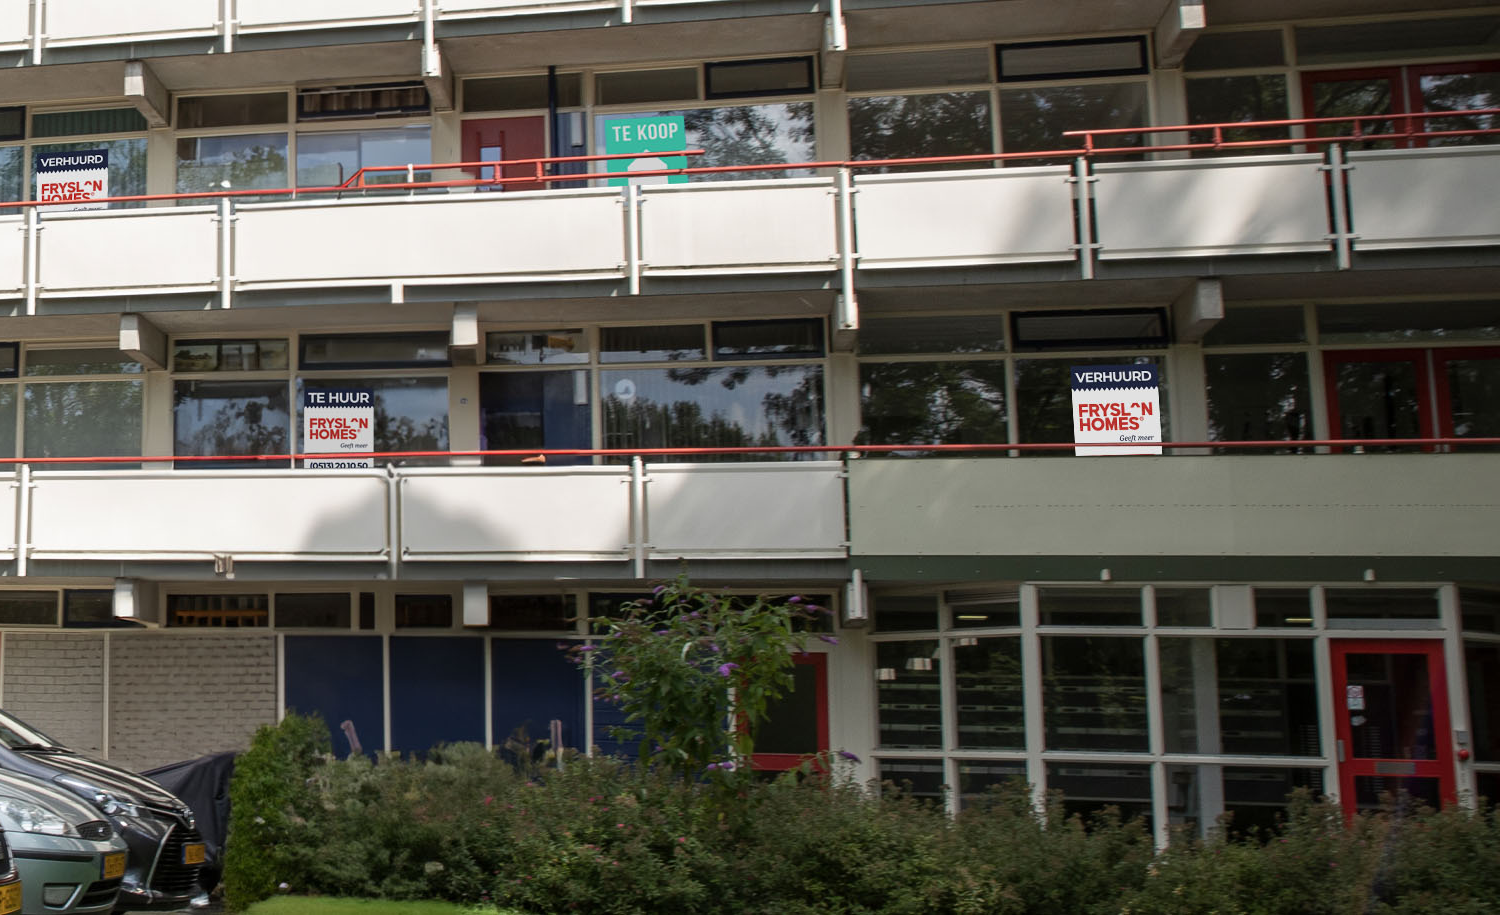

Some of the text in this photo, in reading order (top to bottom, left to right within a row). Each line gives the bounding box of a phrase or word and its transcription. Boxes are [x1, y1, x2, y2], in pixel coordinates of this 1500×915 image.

[612, 123, 678, 142] TE KOOP
[41, 155, 104, 167] VERHUURD
[1075, 371, 1152, 383] VERHUURD
[308, 392, 370, 403] TE HUUR
